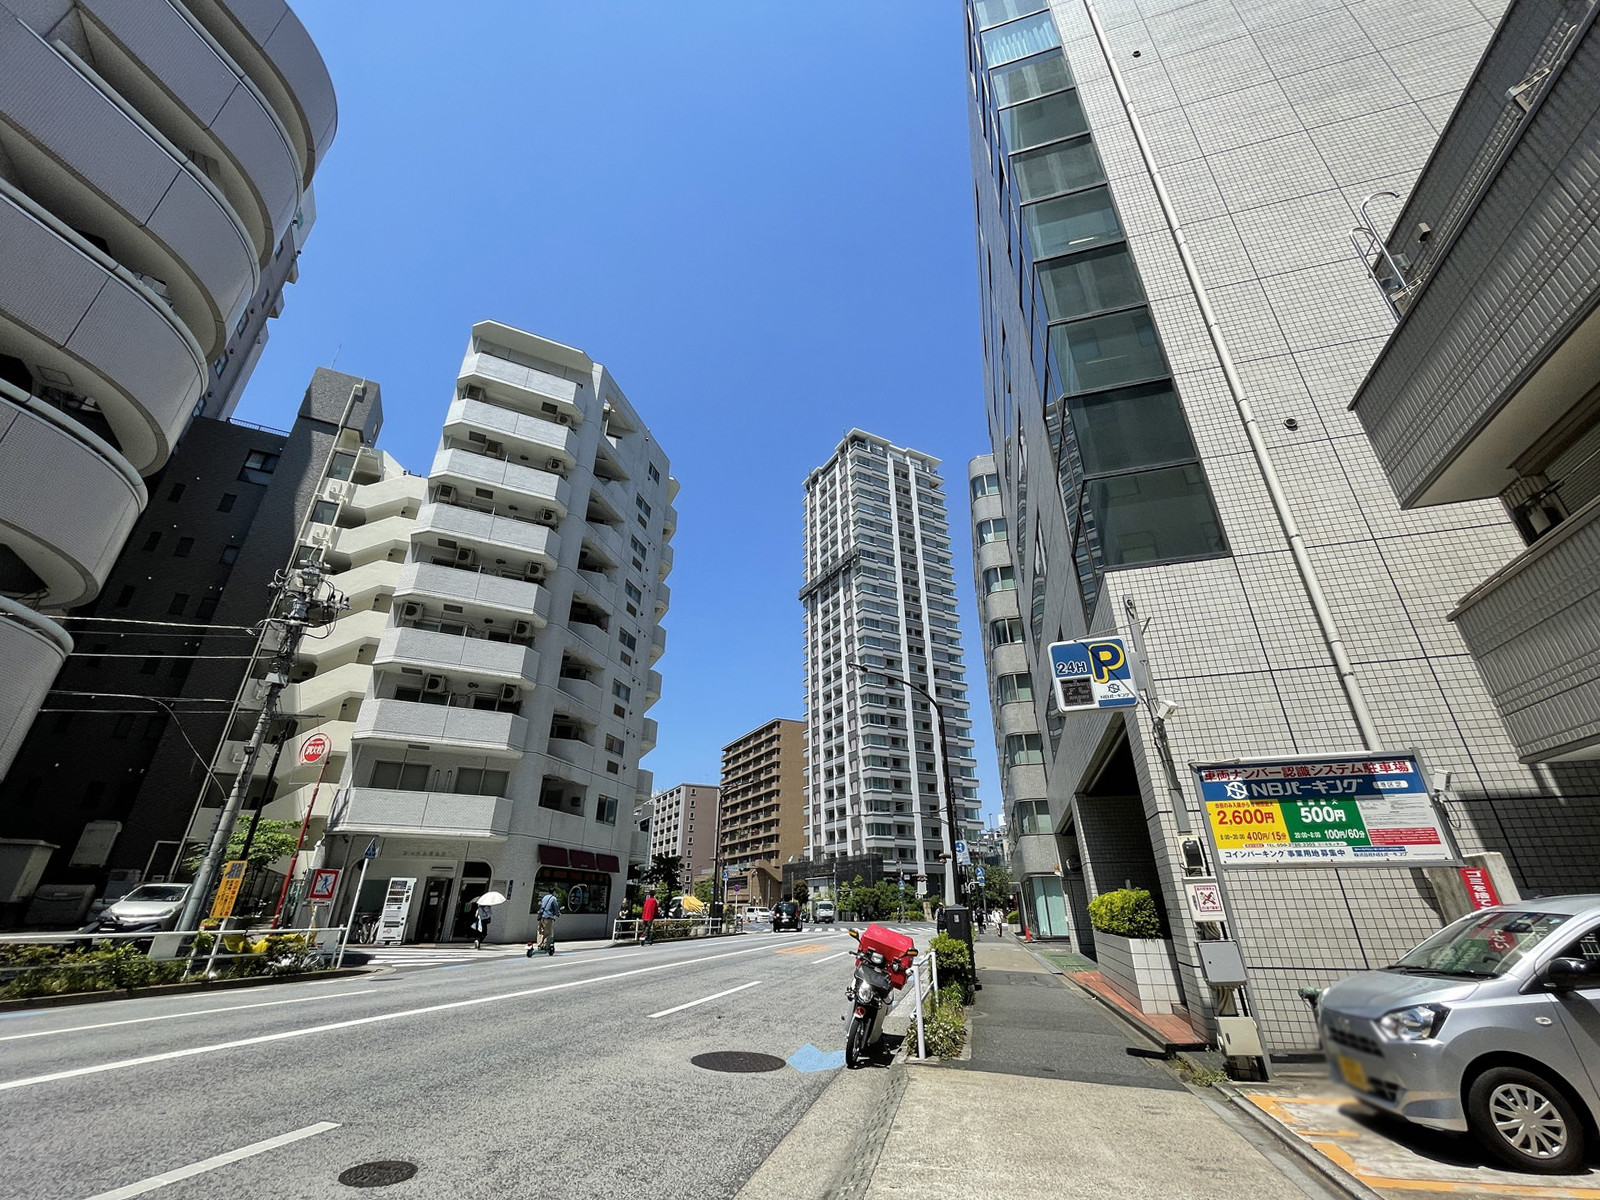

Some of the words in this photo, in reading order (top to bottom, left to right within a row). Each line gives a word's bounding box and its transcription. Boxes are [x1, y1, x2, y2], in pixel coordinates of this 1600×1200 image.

[1057, 661, 1087, 674] 24H
[1088, 643, 1125, 683] P
[1205, 761, 1409, 781] 車両ナンバー認識システム駐車場
[1251, 779, 1363, 797] NBパーキング
[1217, 809, 1275, 825] 2,600円
[1300, 806, 1346, 823] 500円
[1324, 829, 1365, 839] 100円/60分
